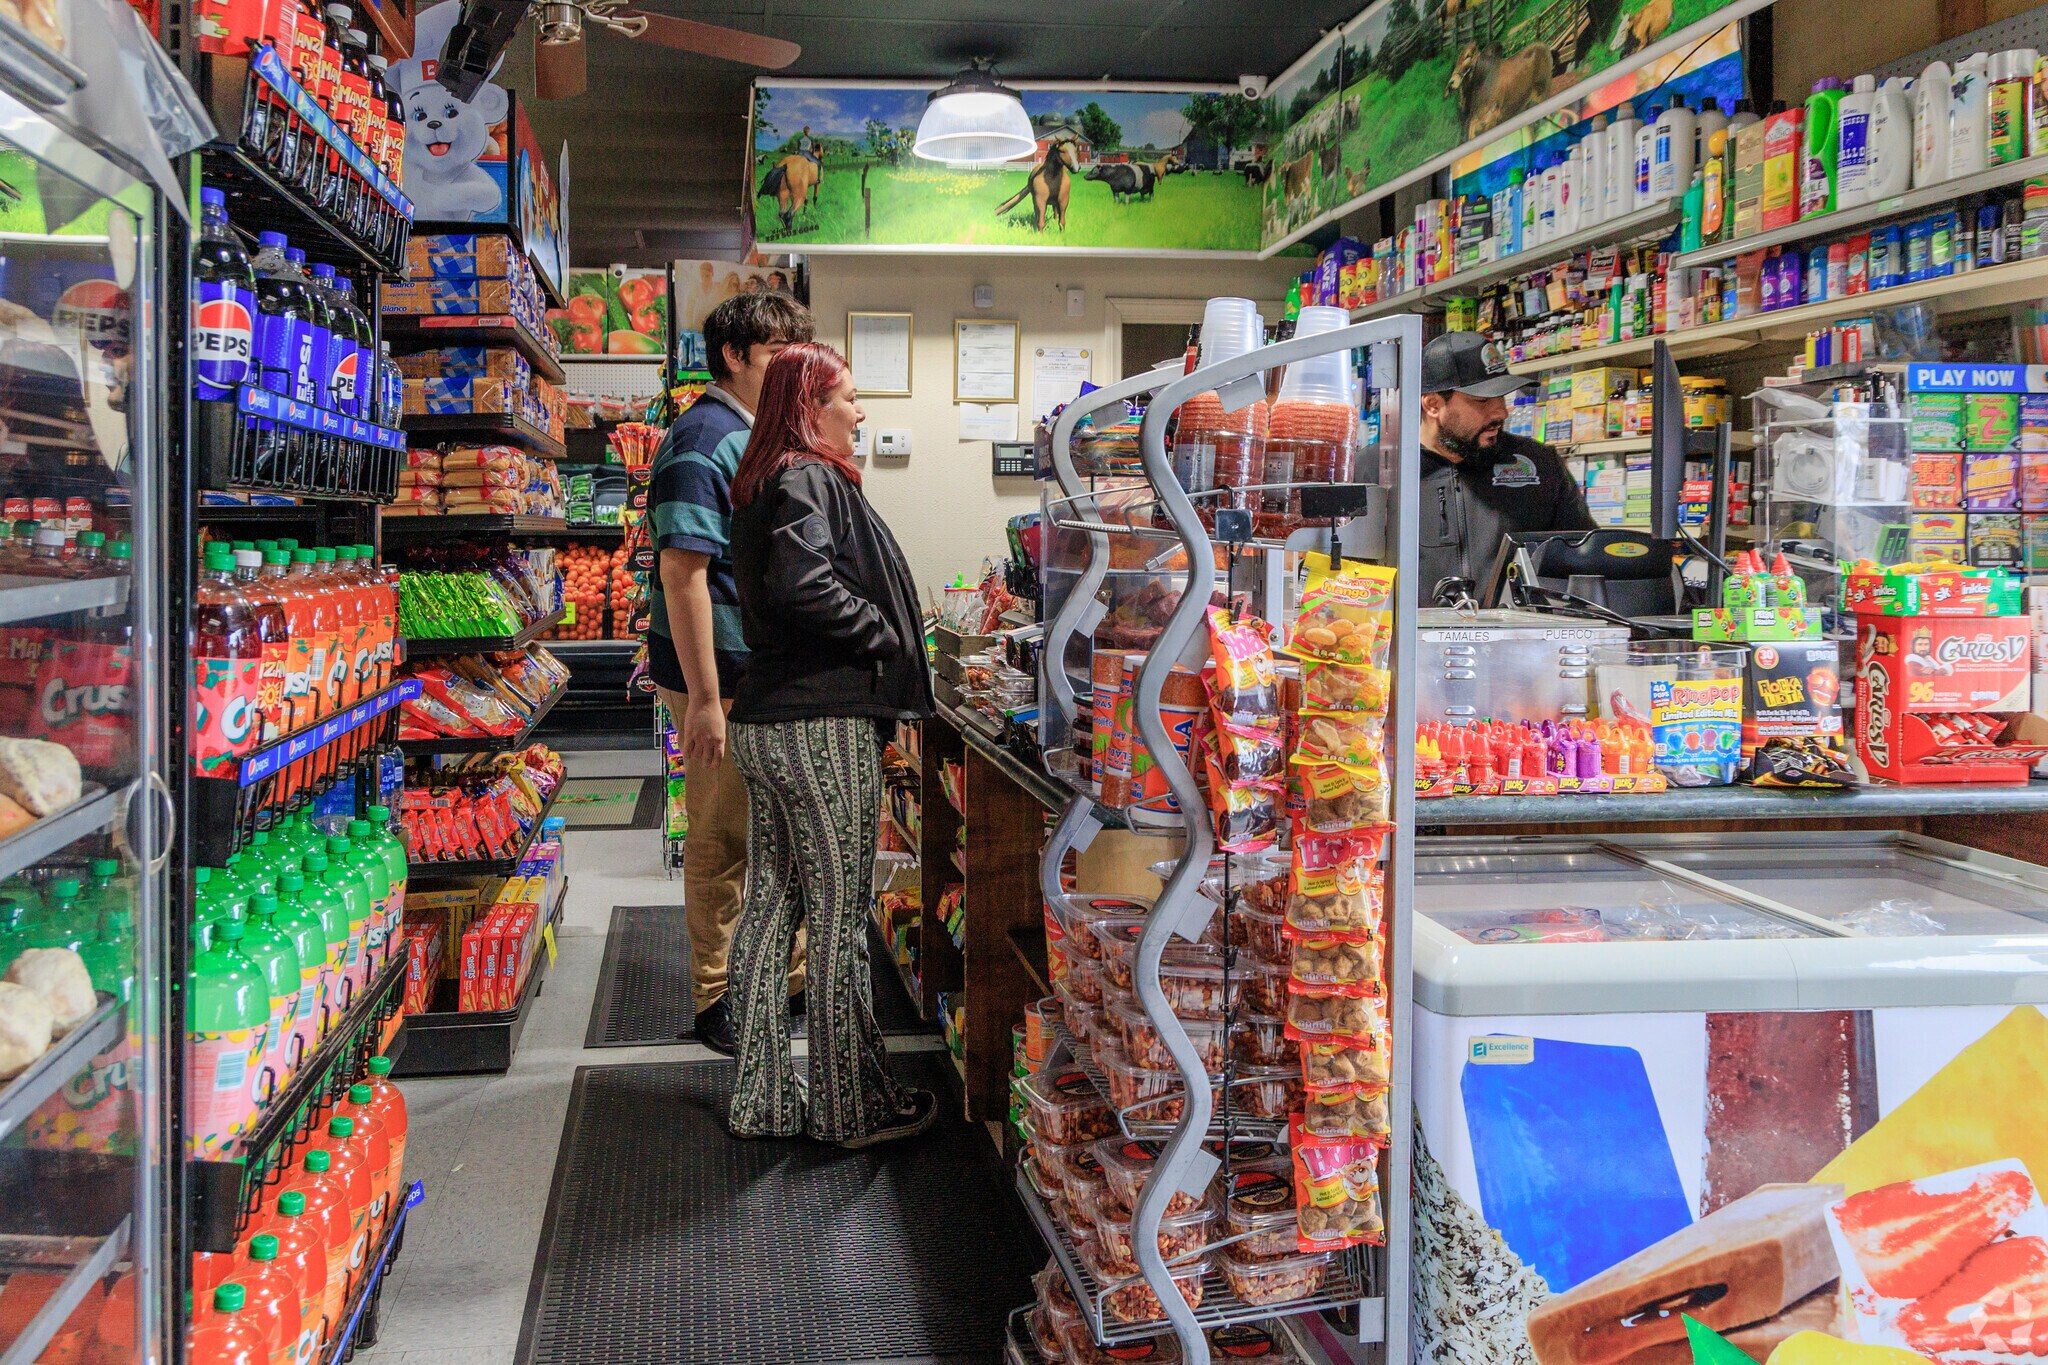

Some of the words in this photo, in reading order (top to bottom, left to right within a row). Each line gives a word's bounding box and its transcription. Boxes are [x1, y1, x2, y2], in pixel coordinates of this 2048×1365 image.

[381, 305, 408, 313] Blanco
[296, 334, 311, 401] EPSI
[1917, 369, 1967, 387] PLAY
[1972, 369, 2016, 387] NOW
[1687, 503, 1708, 513] Advil
[1322, 580, 1370, 600] Mango
[1437, 631, 1490, 642] TAMALES
[1546, 629, 1594, 640] PUERCO
[1760, 649, 1775, 660] 30
[1938, 635, 2011, 663] CARLOS
[1653, 683, 1667, 692] 40
[1909, 681, 1935, 703] 96
[1867, 661, 1890, 743] CARLOS
[1661, 710, 1694, 722] Limited
[1695, 709, 1723, 719] Edition
[1724, 709, 1738, 718] Mix
[1415, 778, 1433, 791] UCAS
[1453, 783, 1472, 793] LUCAS
[1504, 779, 1526, 792] LUCAS
[1560, 777, 1581, 789] LUCAS
[1613, 777, 1635, 790] LUCAS
[1488, 1043, 1529, 1051] Excellence
